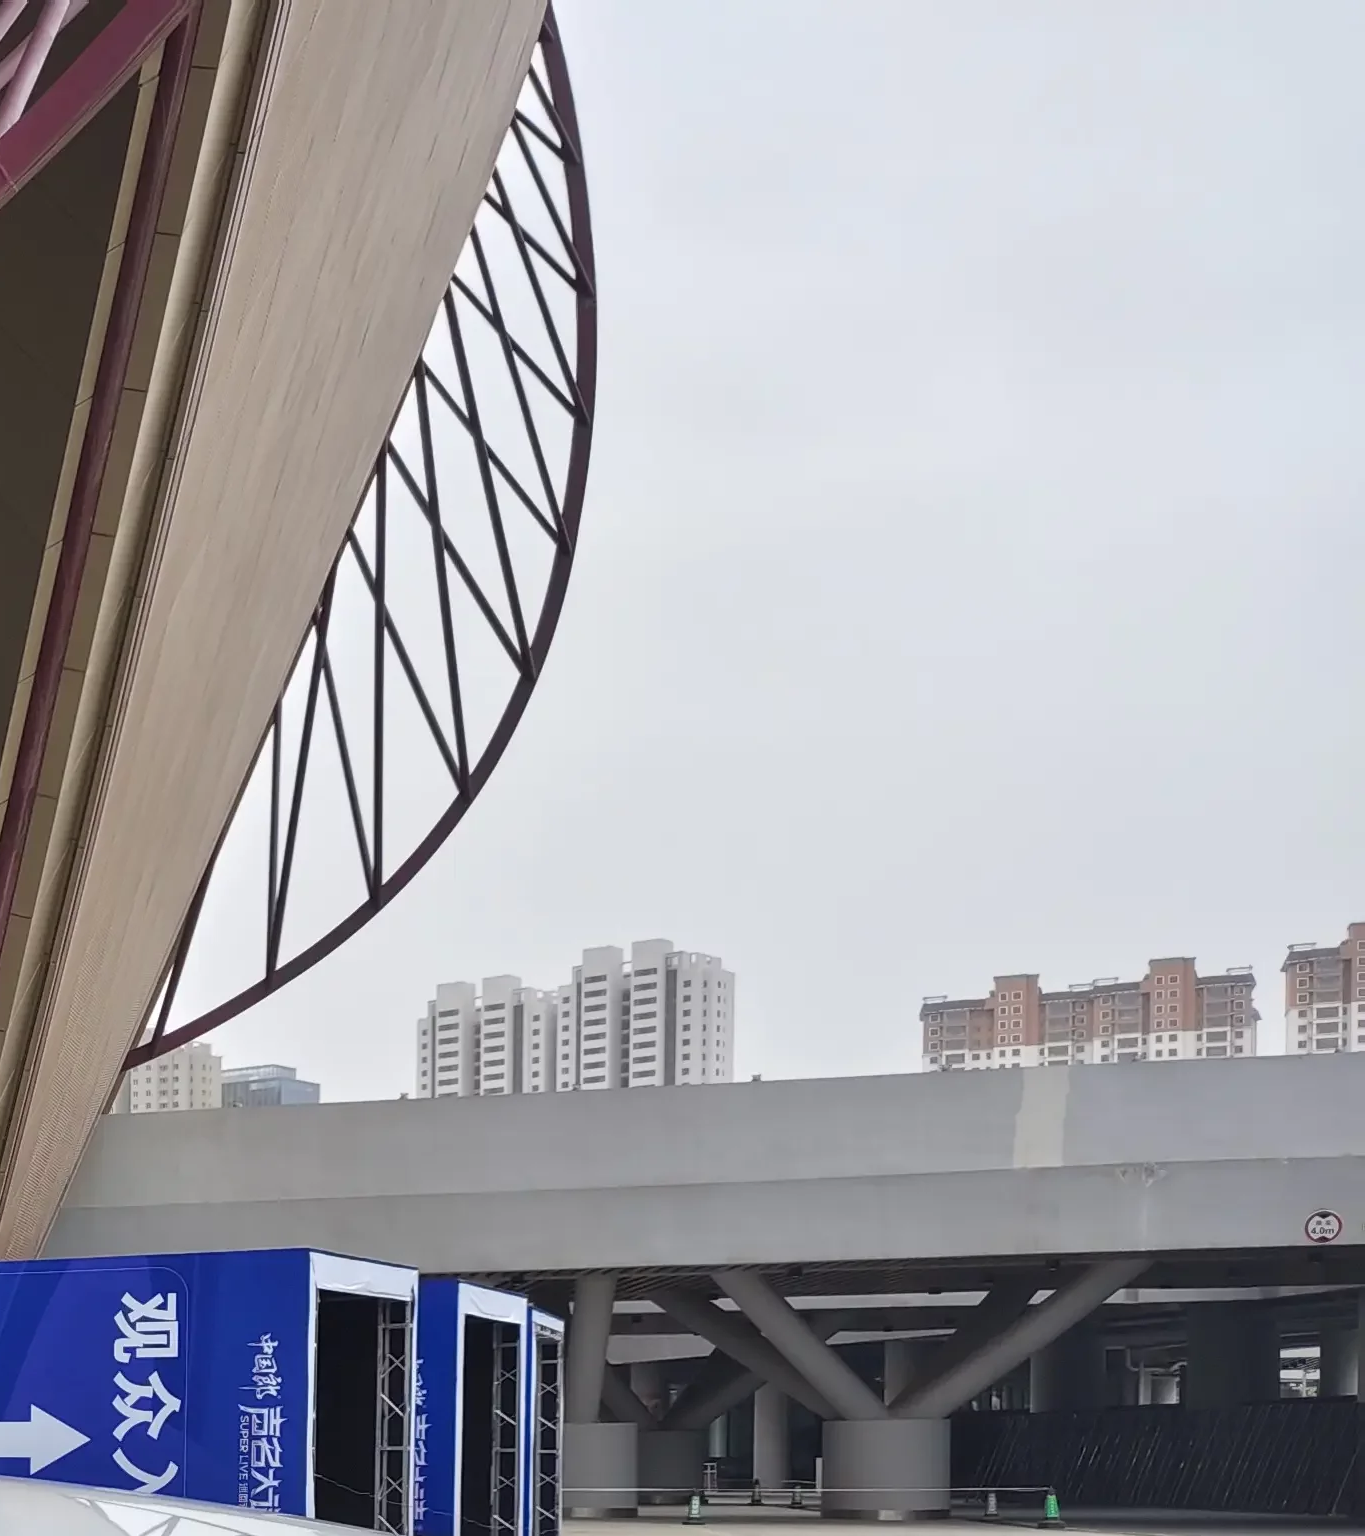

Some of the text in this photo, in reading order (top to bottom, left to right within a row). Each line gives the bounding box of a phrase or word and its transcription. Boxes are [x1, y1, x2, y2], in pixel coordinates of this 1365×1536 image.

[1311, 1227, 1335, 1235] 4.0m
[112, 1291, 181, 1494] 观众入
[239, 1414, 250, 1453] SUPER
[238, 1455, 249, 1481] LIVE
